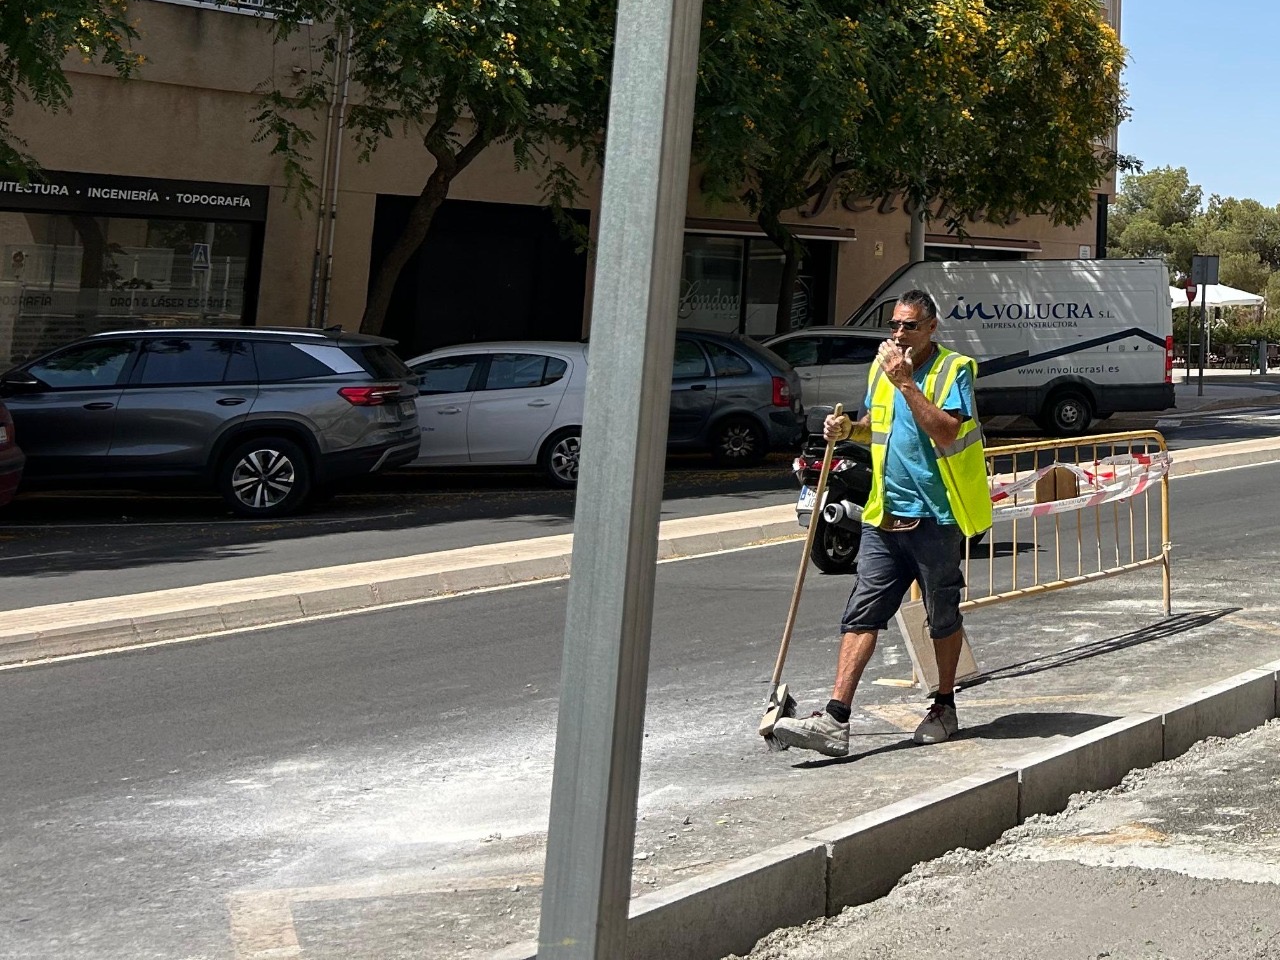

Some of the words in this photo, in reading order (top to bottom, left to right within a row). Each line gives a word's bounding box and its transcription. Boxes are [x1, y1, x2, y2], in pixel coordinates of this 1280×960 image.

[87, 187, 159, 202] INGENIERÍA
[176, 192, 251, 207] TOPOGRAFÍA
[982, 321, 1017, 330] EMPRESA
[1018, 321, 1078, 330] CONSTRUCTORA
